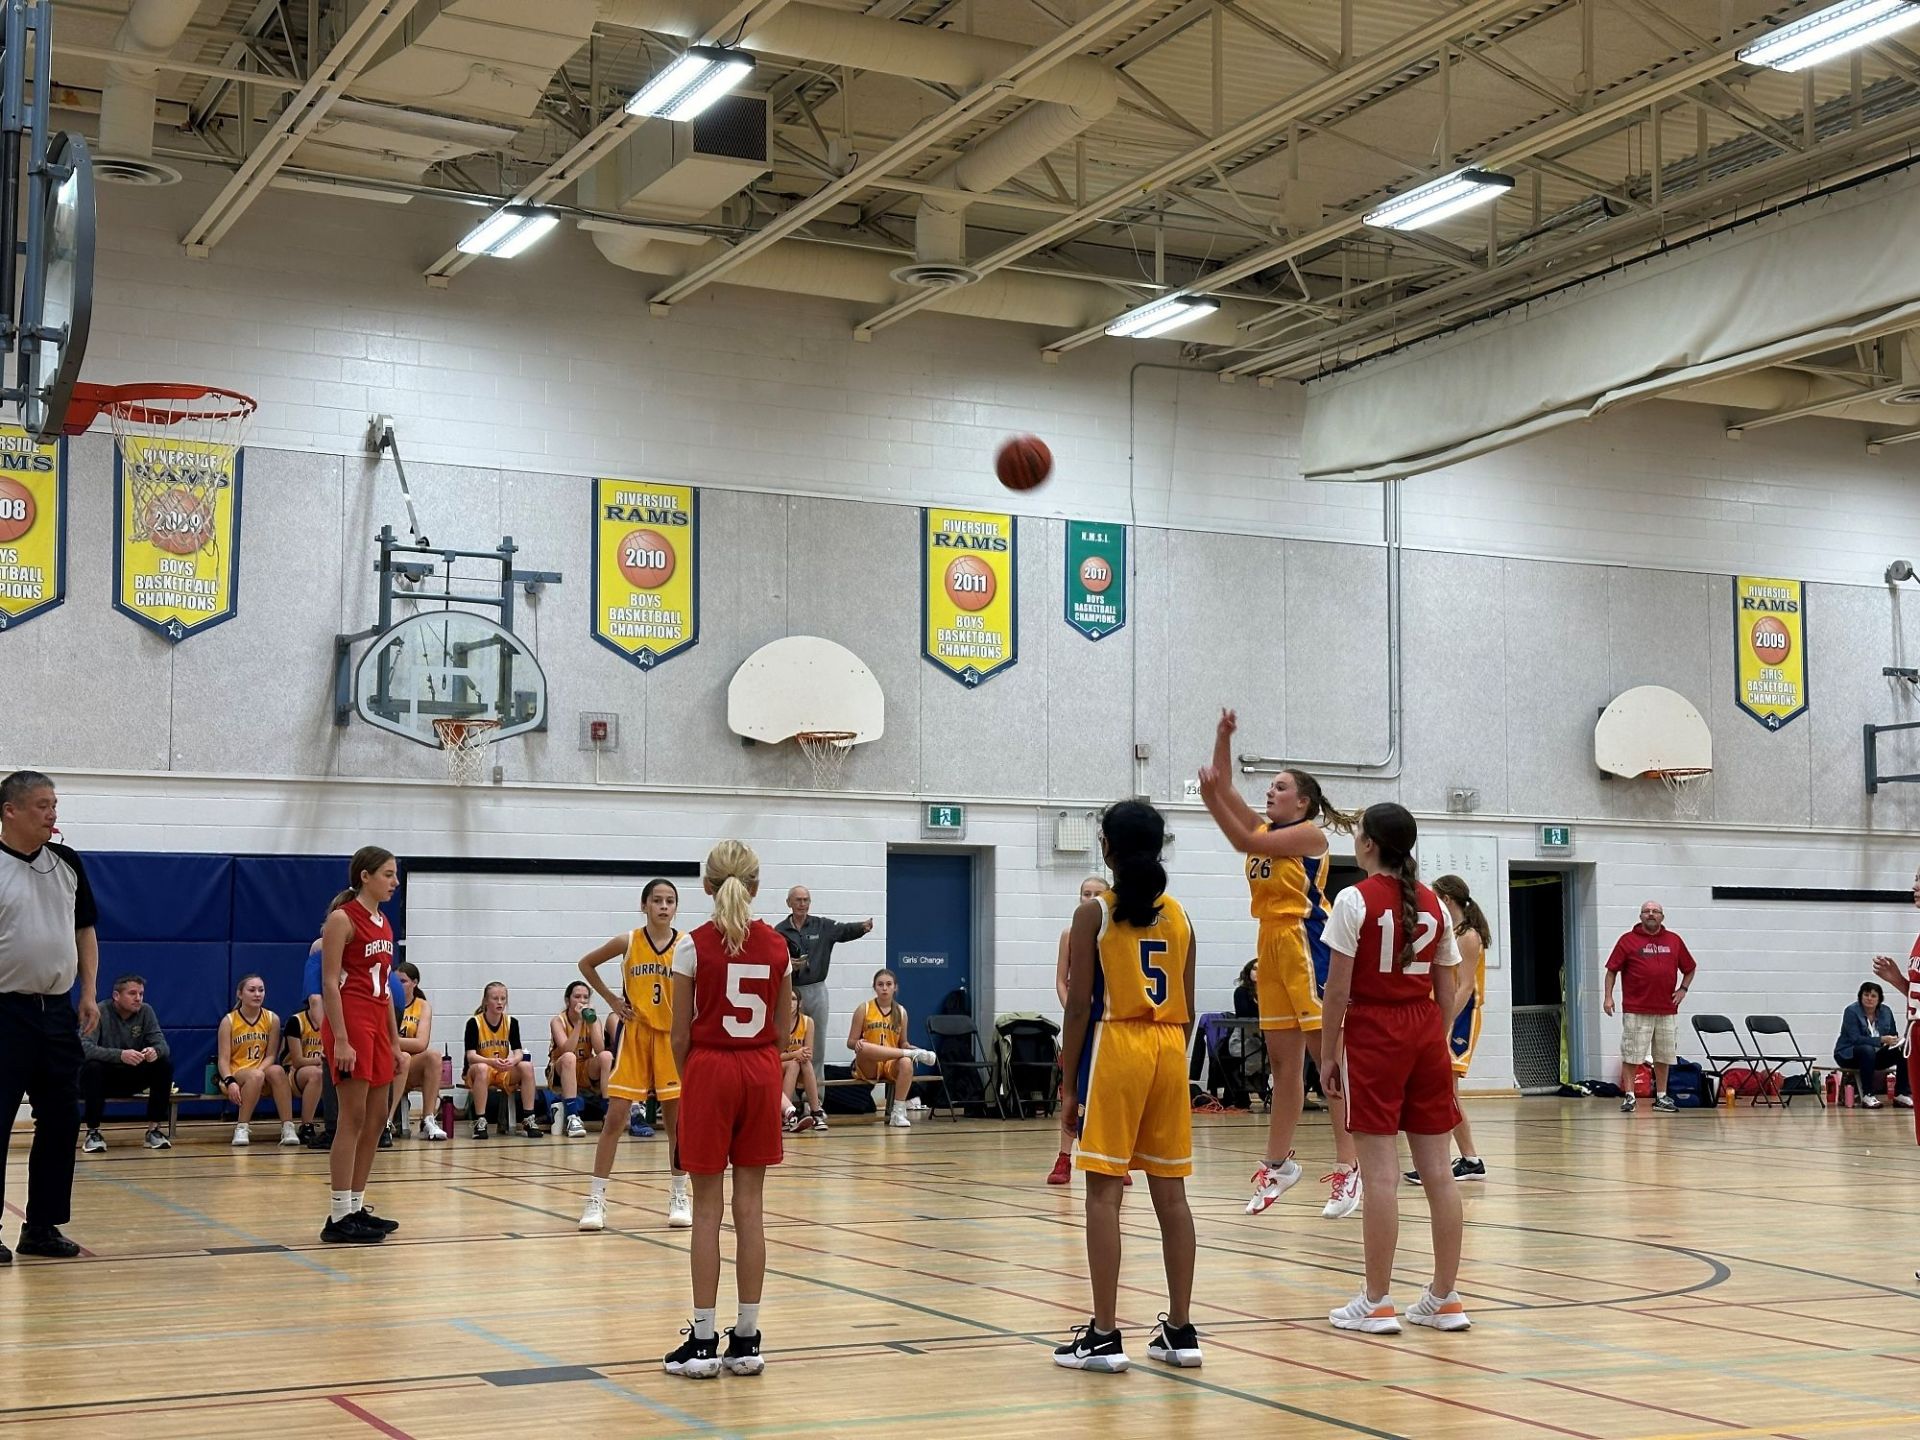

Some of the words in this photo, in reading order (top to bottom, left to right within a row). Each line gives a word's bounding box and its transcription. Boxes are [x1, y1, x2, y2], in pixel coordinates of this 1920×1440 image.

[615, 491, 678, 509] RIVERSIDE
[605, 506, 689, 526] RAMS
[943, 519, 998, 535] RIVERSIDE
[933, 533, 1008, 551] RAMS
[625, 548, 666, 569] 2010
[159, 559, 194, 577] BOYS
[1084, 567, 1107, 580] 2017
[134, 576, 218, 594] BASKETBALL
[953, 572, 988, 592] 2011
[630, 592, 661, 608] BOYS
[1086, 594, 1105, 604] BOYS
[1748, 585, 1791, 599] RIVERSIDE
[135, 593, 216, 611] CHAMPIONS
[1074, 603, 1117, 615] BASKETBALL
[1742, 597, 1798, 613] RAMS
[609, 607, 682, 625] BASKETBALL
[956, 616, 984, 629] BOYS
[1074, 613, 1116, 624] CHAMPIONS
[609, 623, 682, 639] CHAMPIONS
[937, 628, 1001, 644] BASKETBALL
[1755, 632, 1785, 649] 2009
[938, 643, 1002, 659] CHAMPIONS
[1760, 668, 1784, 681] GIRLS
[1747, 681, 1797, 694] BASKETBALL
[1748, 693, 1796, 706] CHAMPIONS
[1249, 857, 1271, 879] 26
[1377, 908, 1438, 975] 12
[919, 956, 945, 966] Change
[1139, 938, 1168, 1008] 5
[652, 983, 662, 1005] 3
[722, 963, 771, 1039] 5
[247, 1045, 260, 1060] 12
